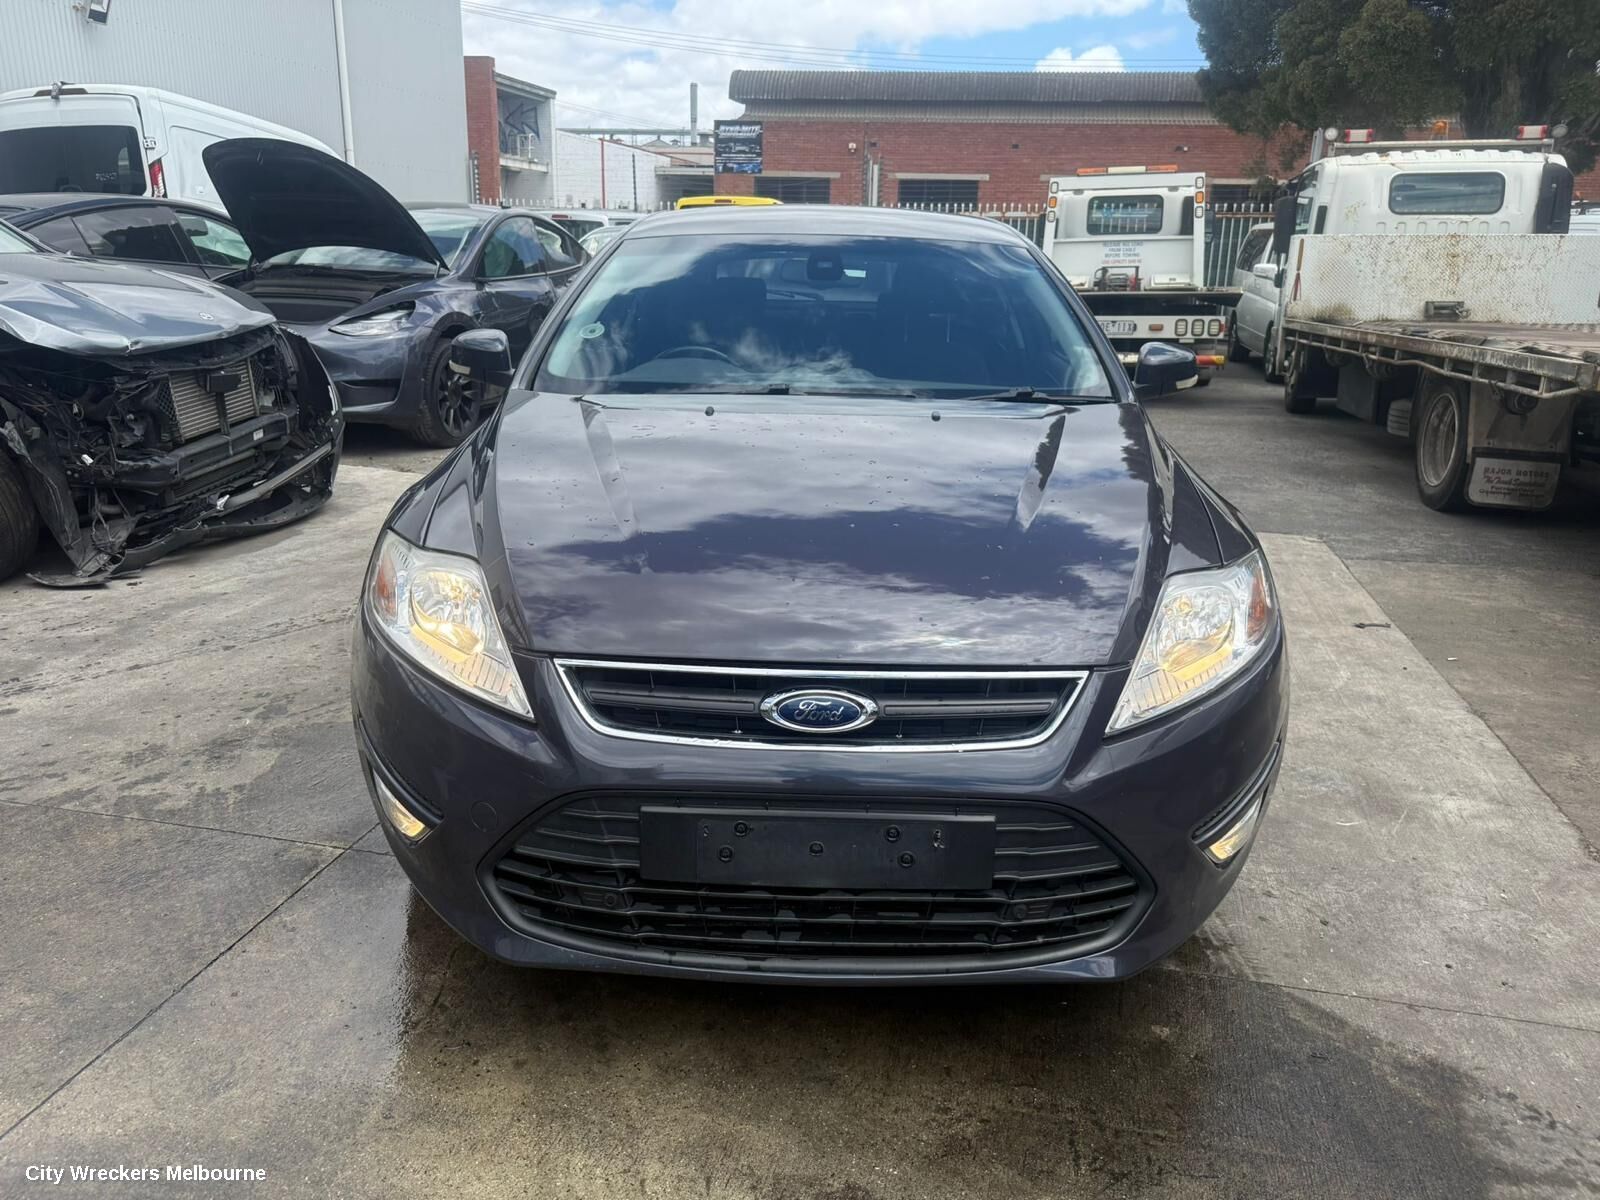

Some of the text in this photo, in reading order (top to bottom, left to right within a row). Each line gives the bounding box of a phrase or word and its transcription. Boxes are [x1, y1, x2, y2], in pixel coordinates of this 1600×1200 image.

[1483, 467, 1549, 478] MAJOR MOTORS
[794, 700, 845, 720] Ford
